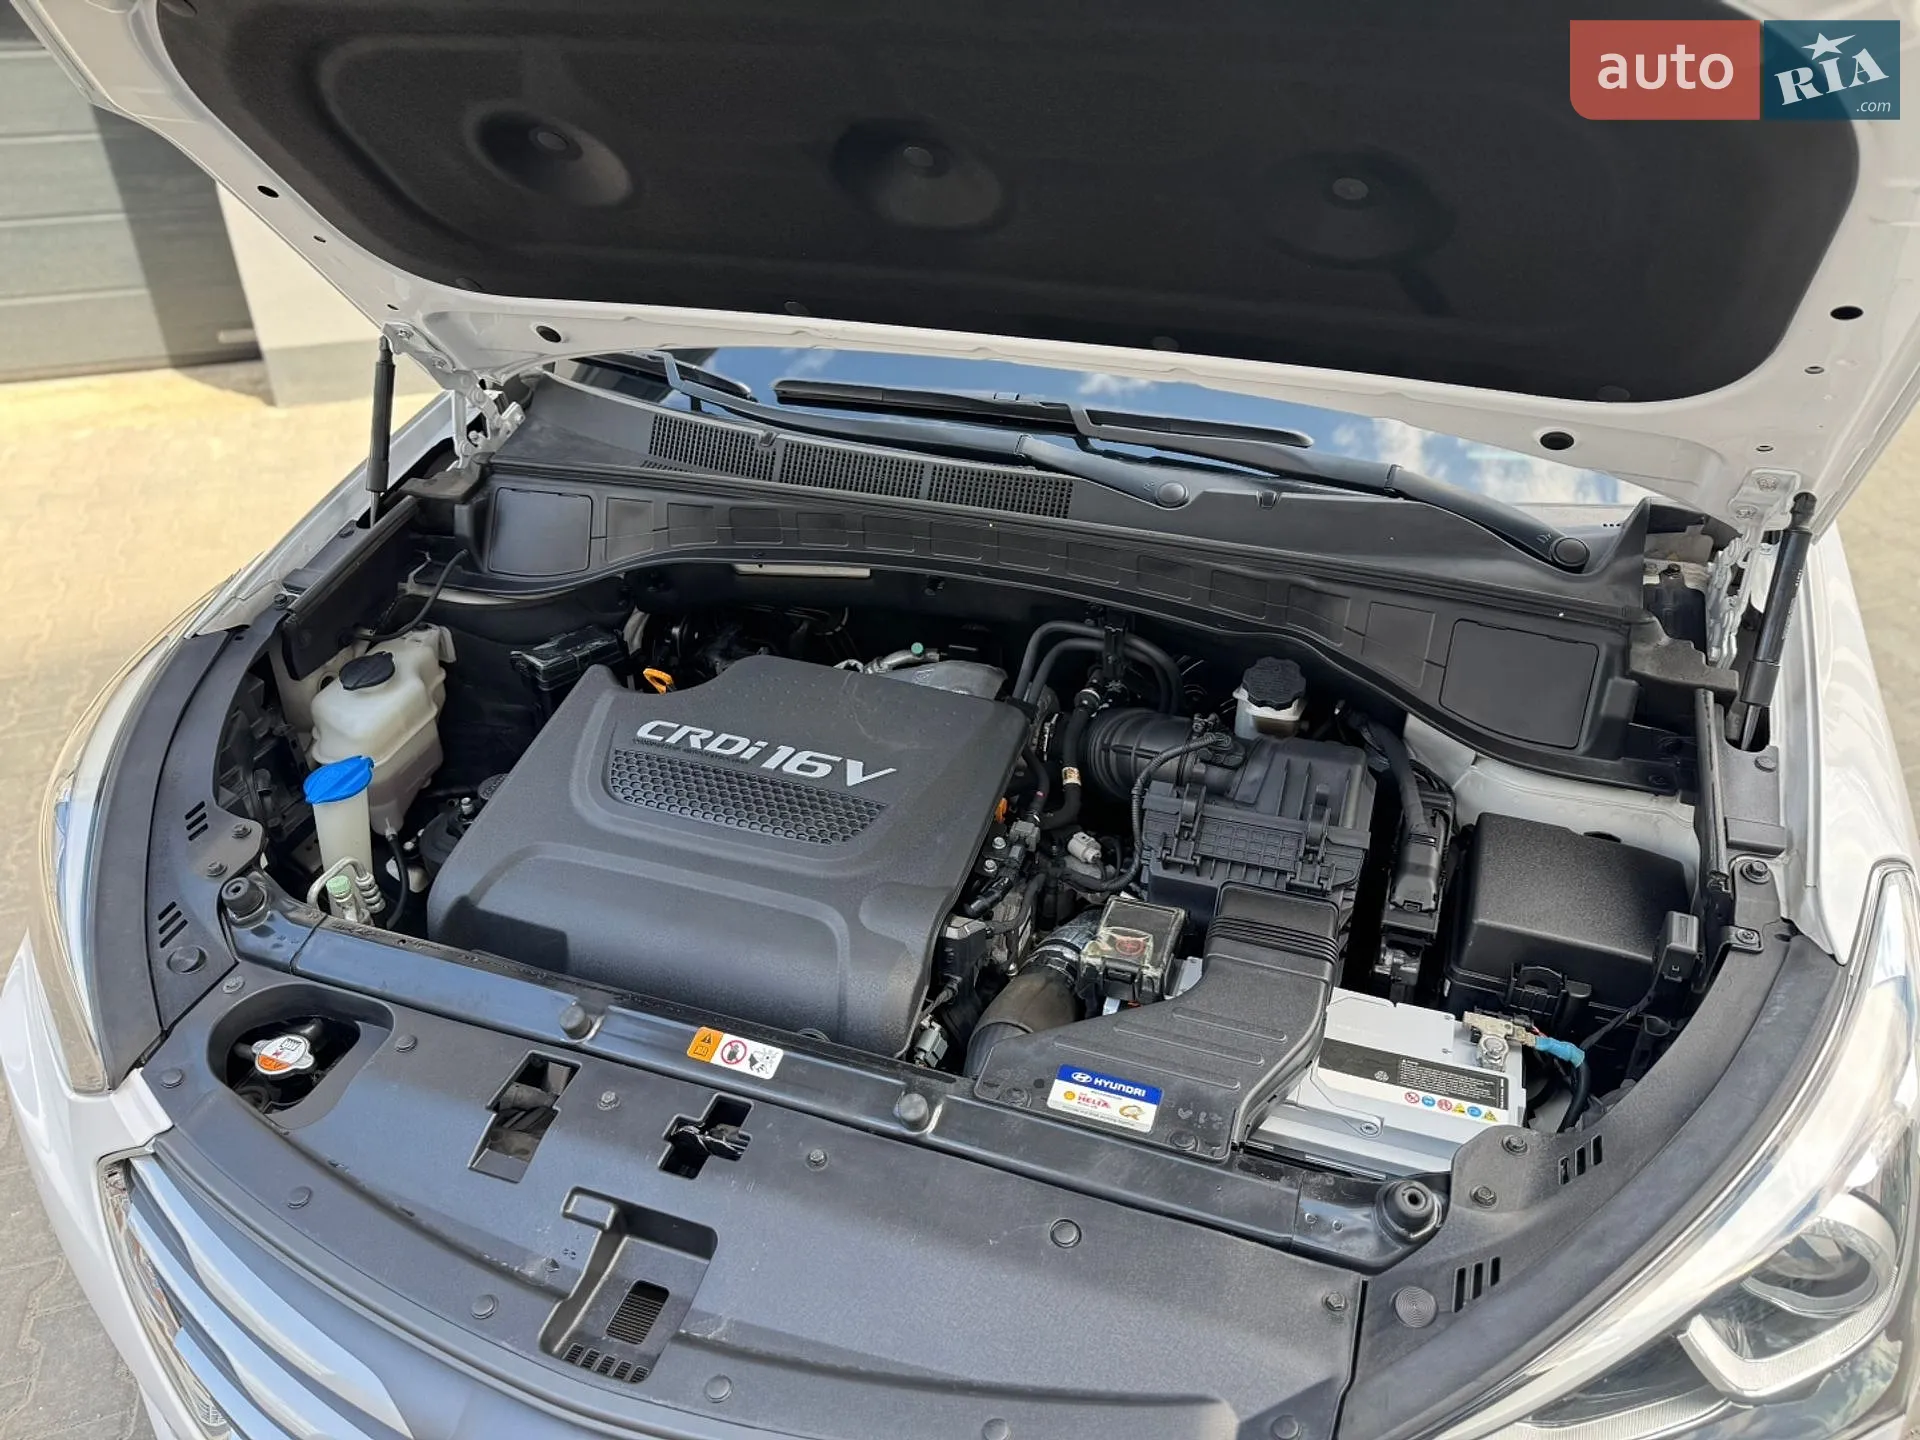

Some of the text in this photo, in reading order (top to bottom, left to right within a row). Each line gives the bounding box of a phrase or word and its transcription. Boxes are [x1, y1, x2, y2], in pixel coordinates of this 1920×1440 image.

[636, 720, 897, 787] CRDi 16V
[1094, 1077, 1147, 1098] HYUNDAI
